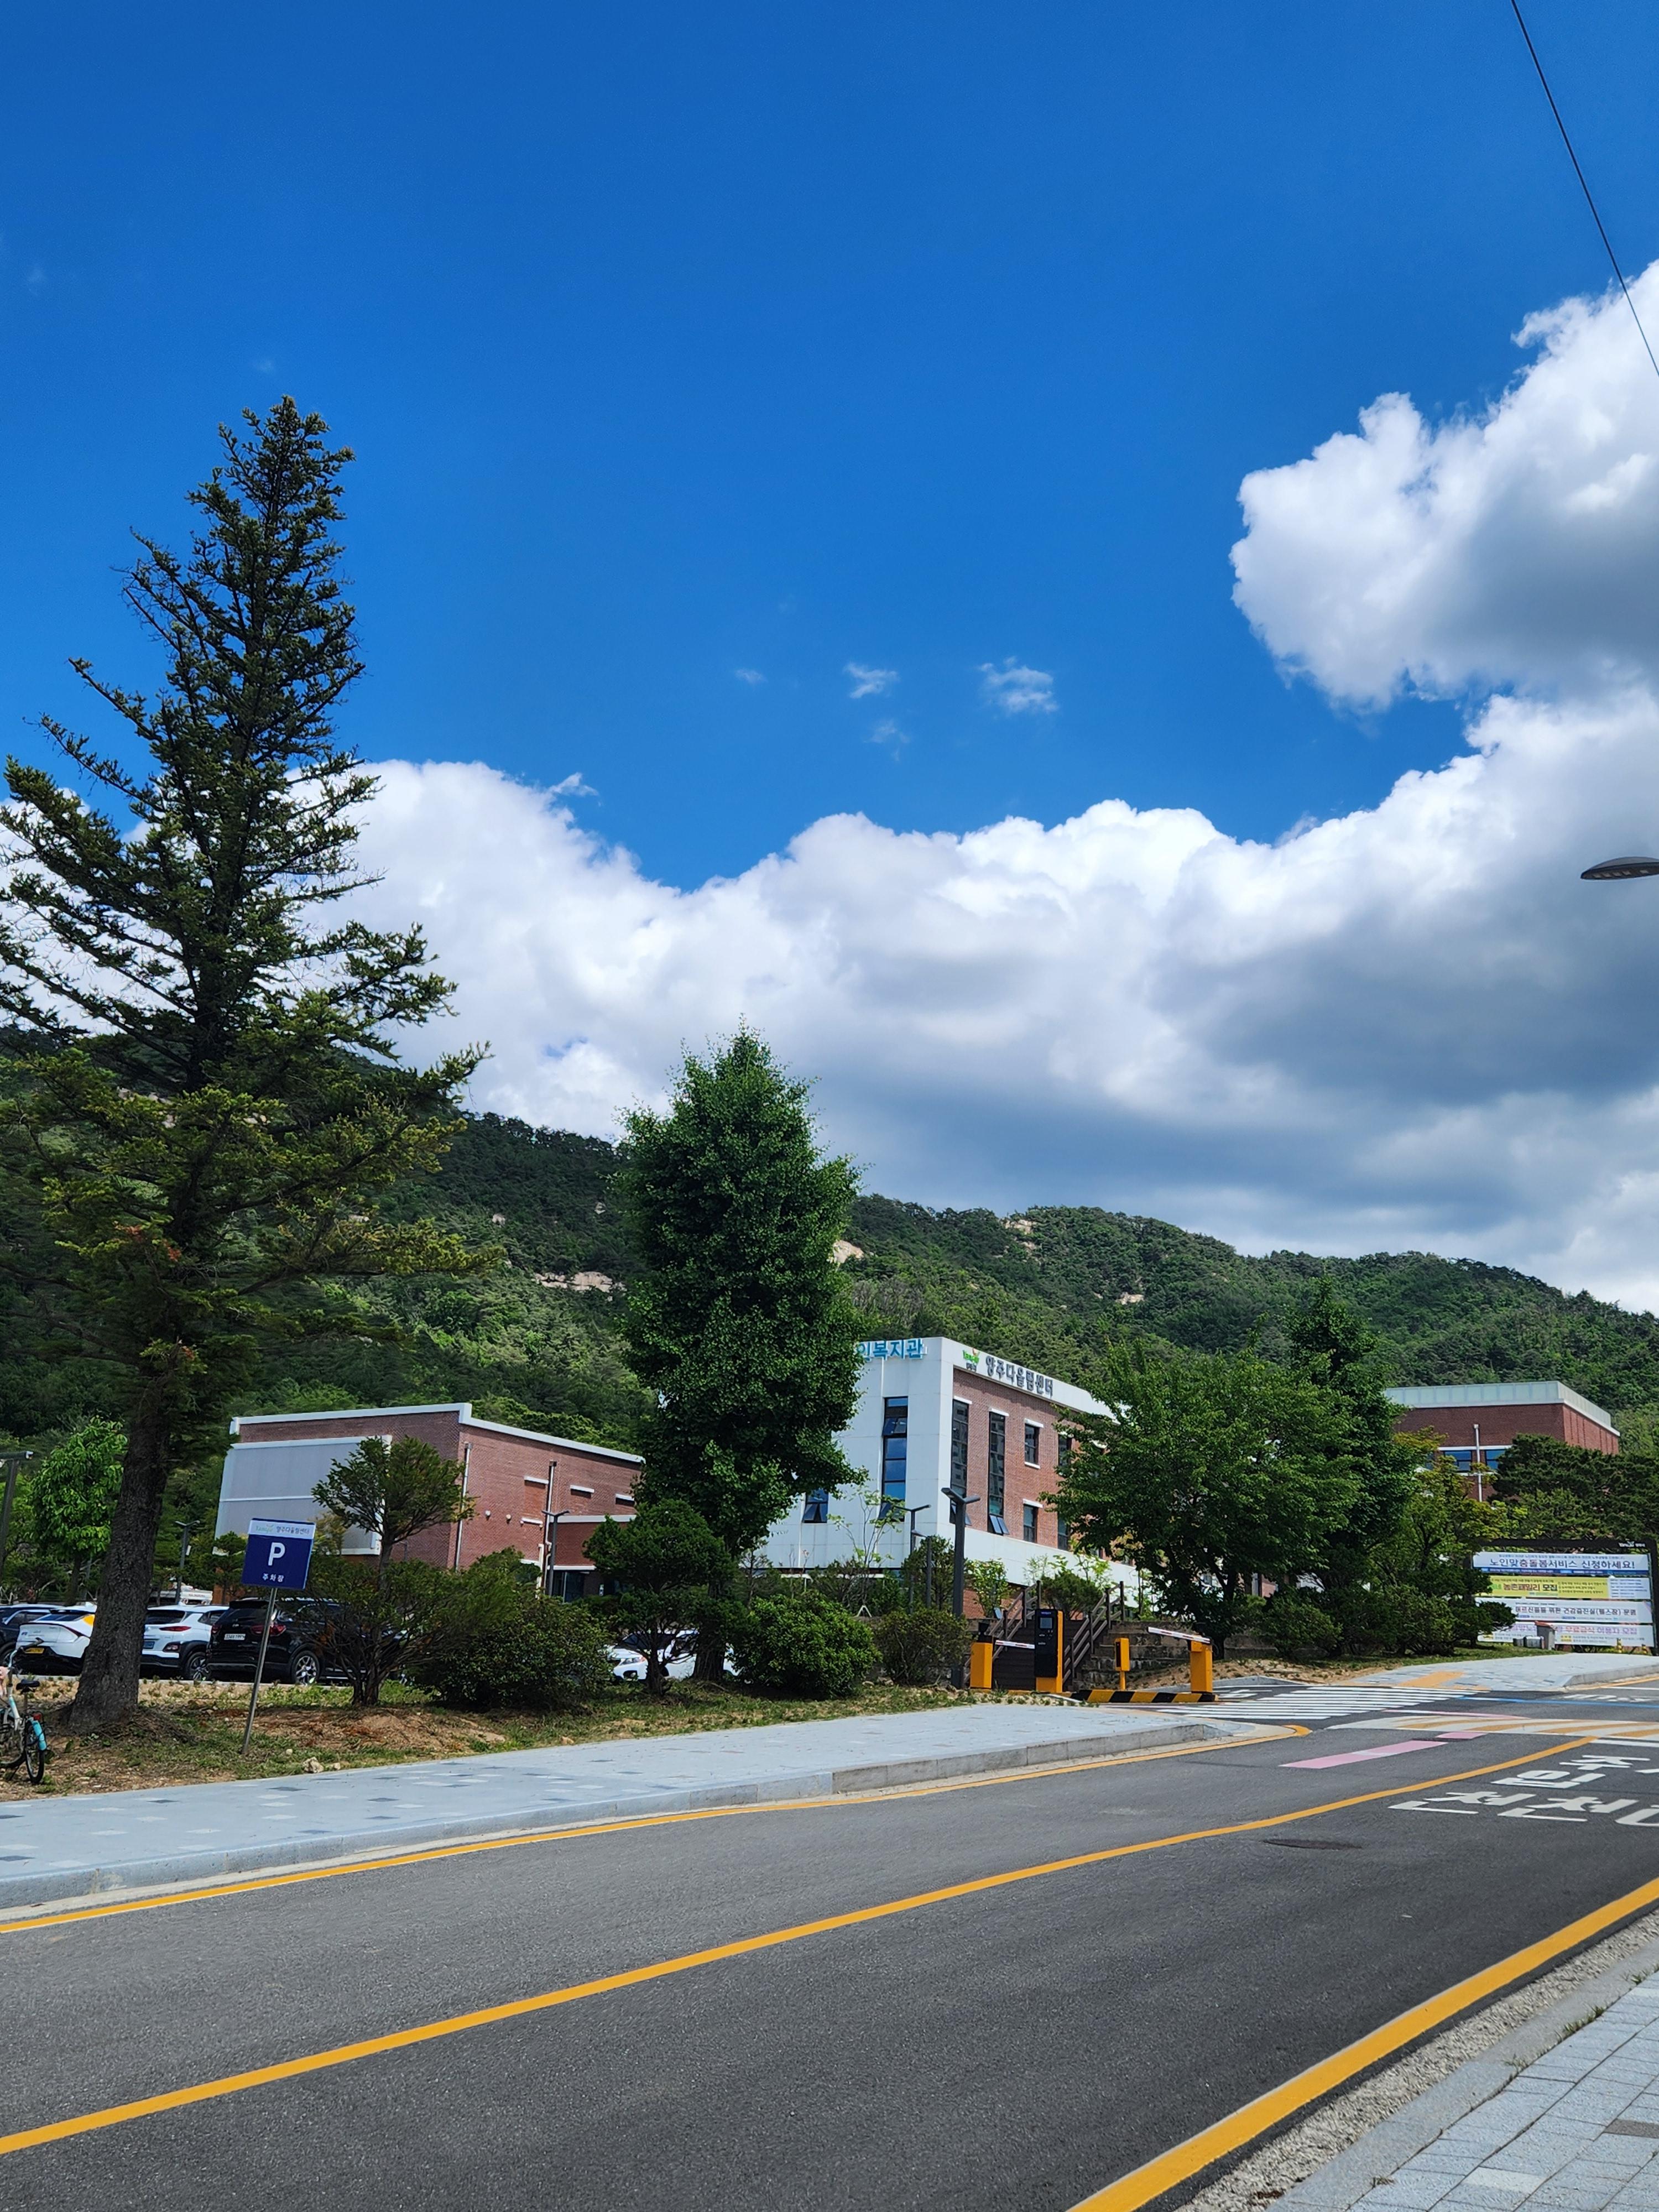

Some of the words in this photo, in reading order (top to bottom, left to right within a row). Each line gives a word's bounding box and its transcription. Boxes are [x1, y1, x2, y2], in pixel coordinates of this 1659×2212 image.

[985, 1355, 1053, 1398] 양주다울림센터
[268, 1542, 285, 1566] P
[1489, 1558, 1578, 1568] 노인맞춤돌봄서비스
[1582, 1561, 1635, 1569] 신청하세요!
[262, 1573, 284, 1582] 주차장
